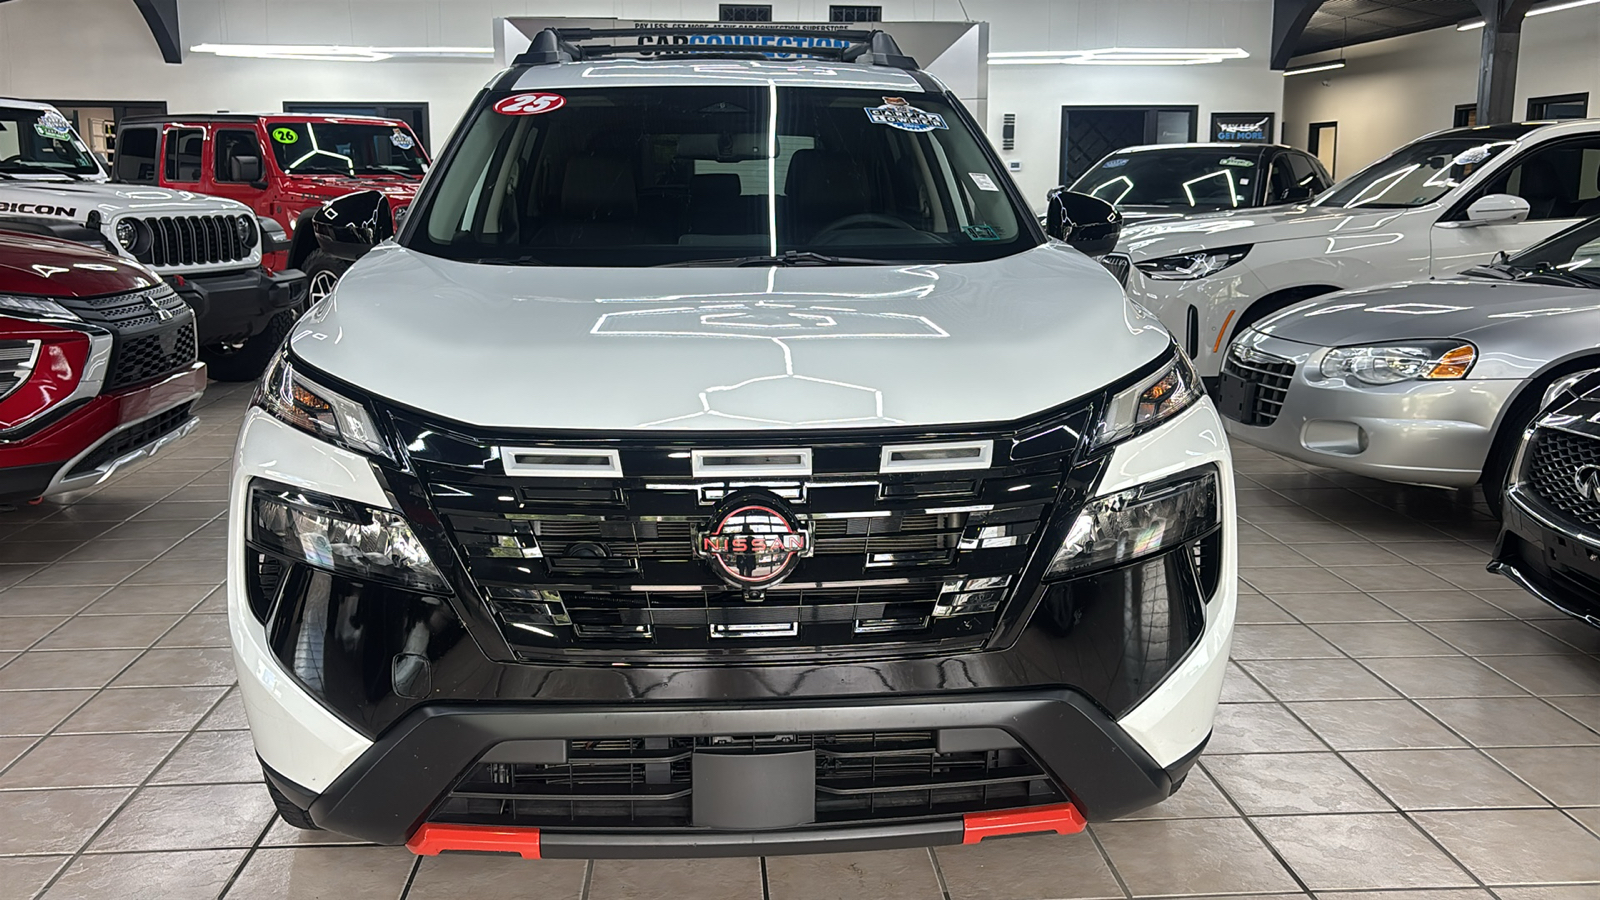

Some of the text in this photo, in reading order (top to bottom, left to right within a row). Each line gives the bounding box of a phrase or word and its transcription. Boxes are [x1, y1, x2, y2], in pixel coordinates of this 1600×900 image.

[501, 95, 560, 112] 25
[277, 130, 294, 141] 26
[1217, 132, 1235, 140] GET
[704, 536, 804, 552] NISSAN
